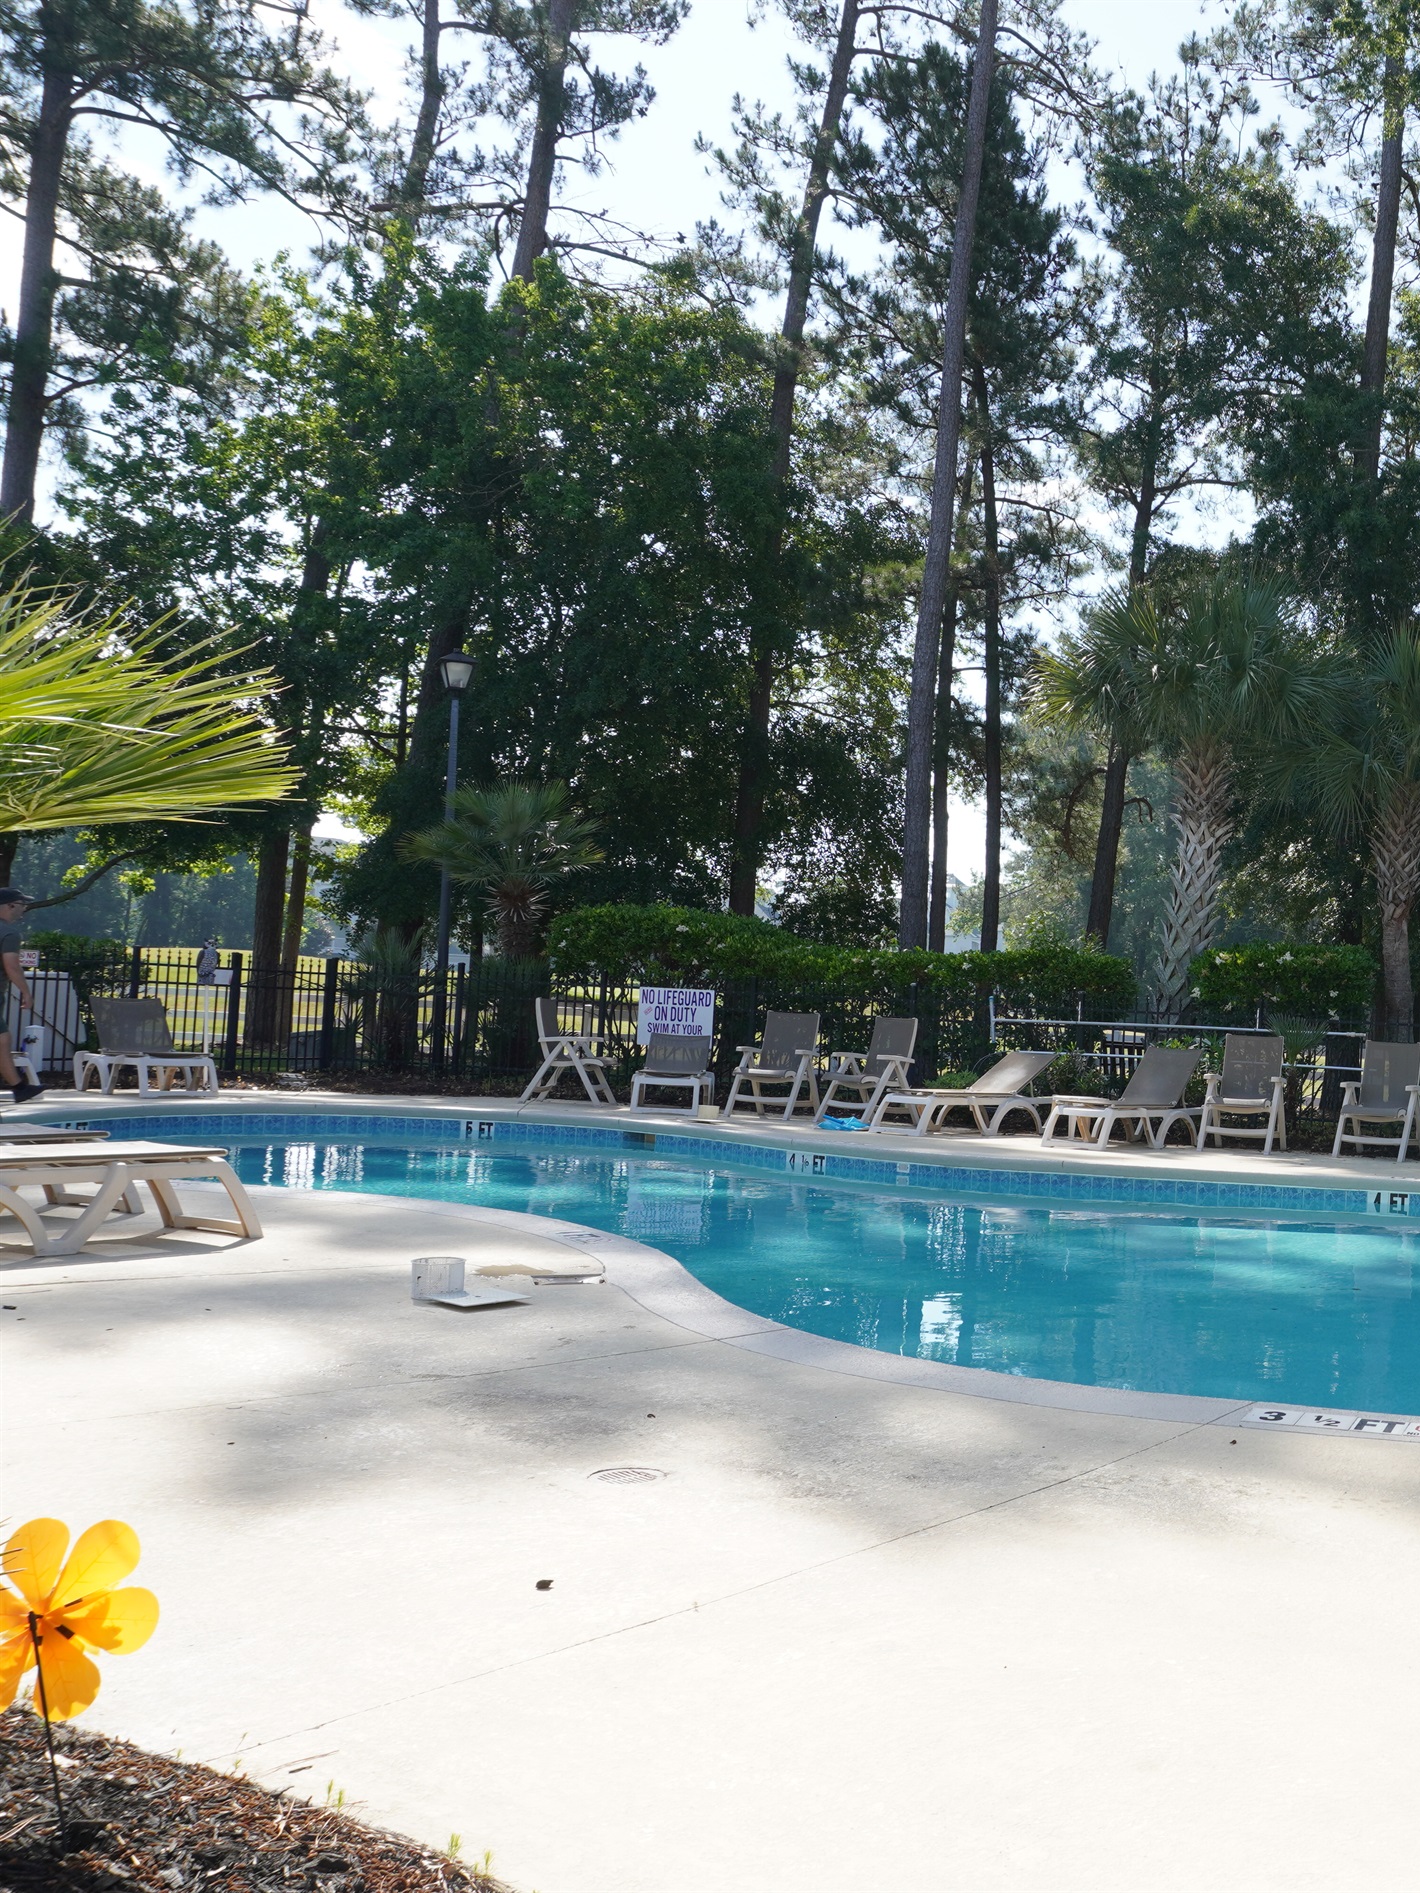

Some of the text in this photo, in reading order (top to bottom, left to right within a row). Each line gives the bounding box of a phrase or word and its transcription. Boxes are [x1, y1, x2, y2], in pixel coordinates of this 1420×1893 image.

[641, 989, 712, 1007] NO LIFEGUARD
[654, 1006, 668, 1021] ON
[670, 1006, 697, 1023] DUTY
[647, 1022, 703, 1035] SWIM AT YOUR
[1259, 1411, 1287, 1422] 3
[1354, 1418, 1406, 1434] FT
